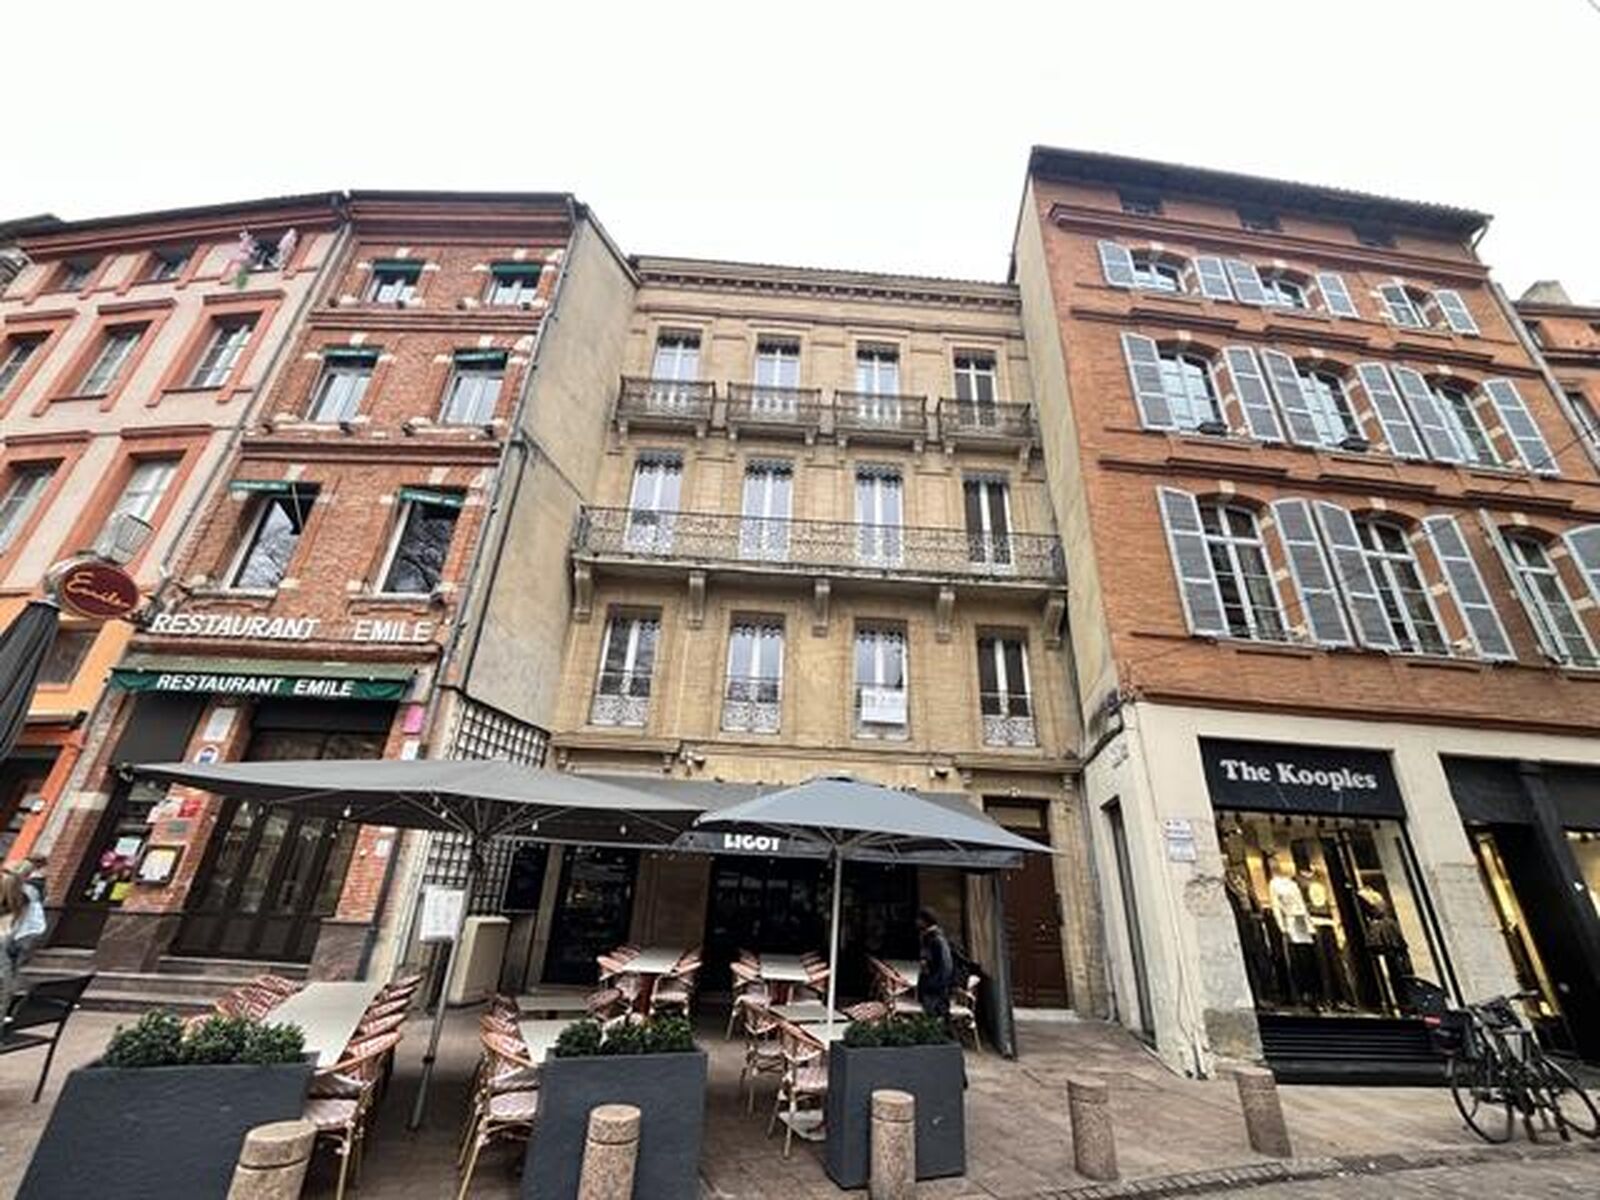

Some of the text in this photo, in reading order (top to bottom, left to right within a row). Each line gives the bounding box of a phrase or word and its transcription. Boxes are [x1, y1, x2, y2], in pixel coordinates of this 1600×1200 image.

[151, 613, 433, 642] RESTAURANT EMILE
[156, 674, 355, 697] RESTAURANT EMILE
[1220, 759, 1378, 792] The Kooples
